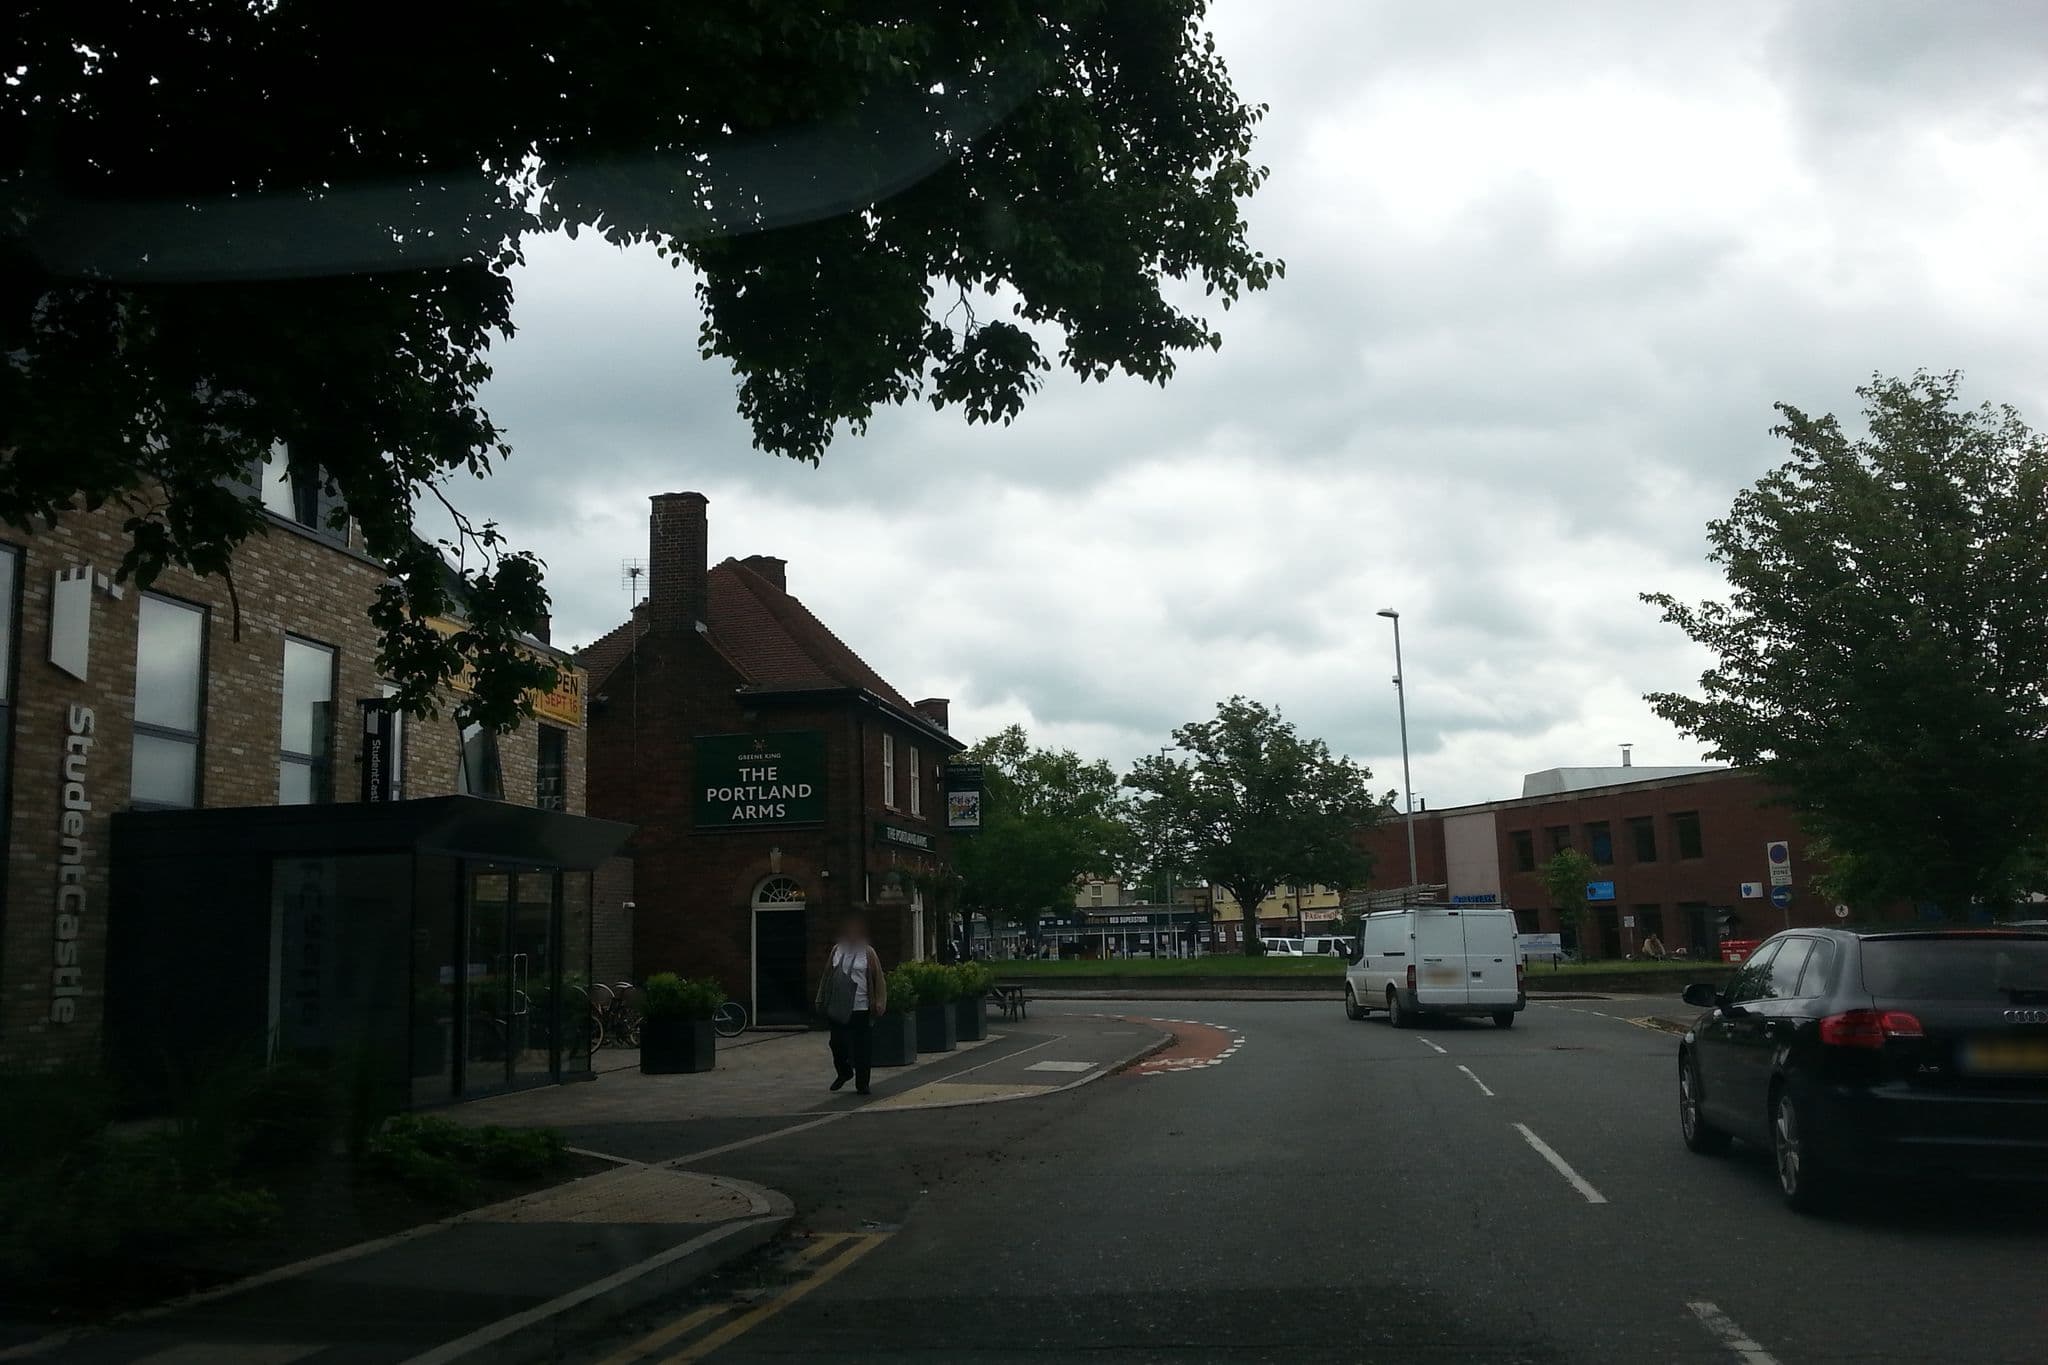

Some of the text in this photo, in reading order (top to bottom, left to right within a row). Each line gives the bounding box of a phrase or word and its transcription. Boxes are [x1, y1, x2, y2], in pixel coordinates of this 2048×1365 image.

[544, 692, 567, 711] SEPT
[738, 766, 778, 782] THE
[706, 783, 812, 803] PORTLAND
[731, 804, 786, 820] ARMS
[50, 702, 96, 1026] StudentCastle
